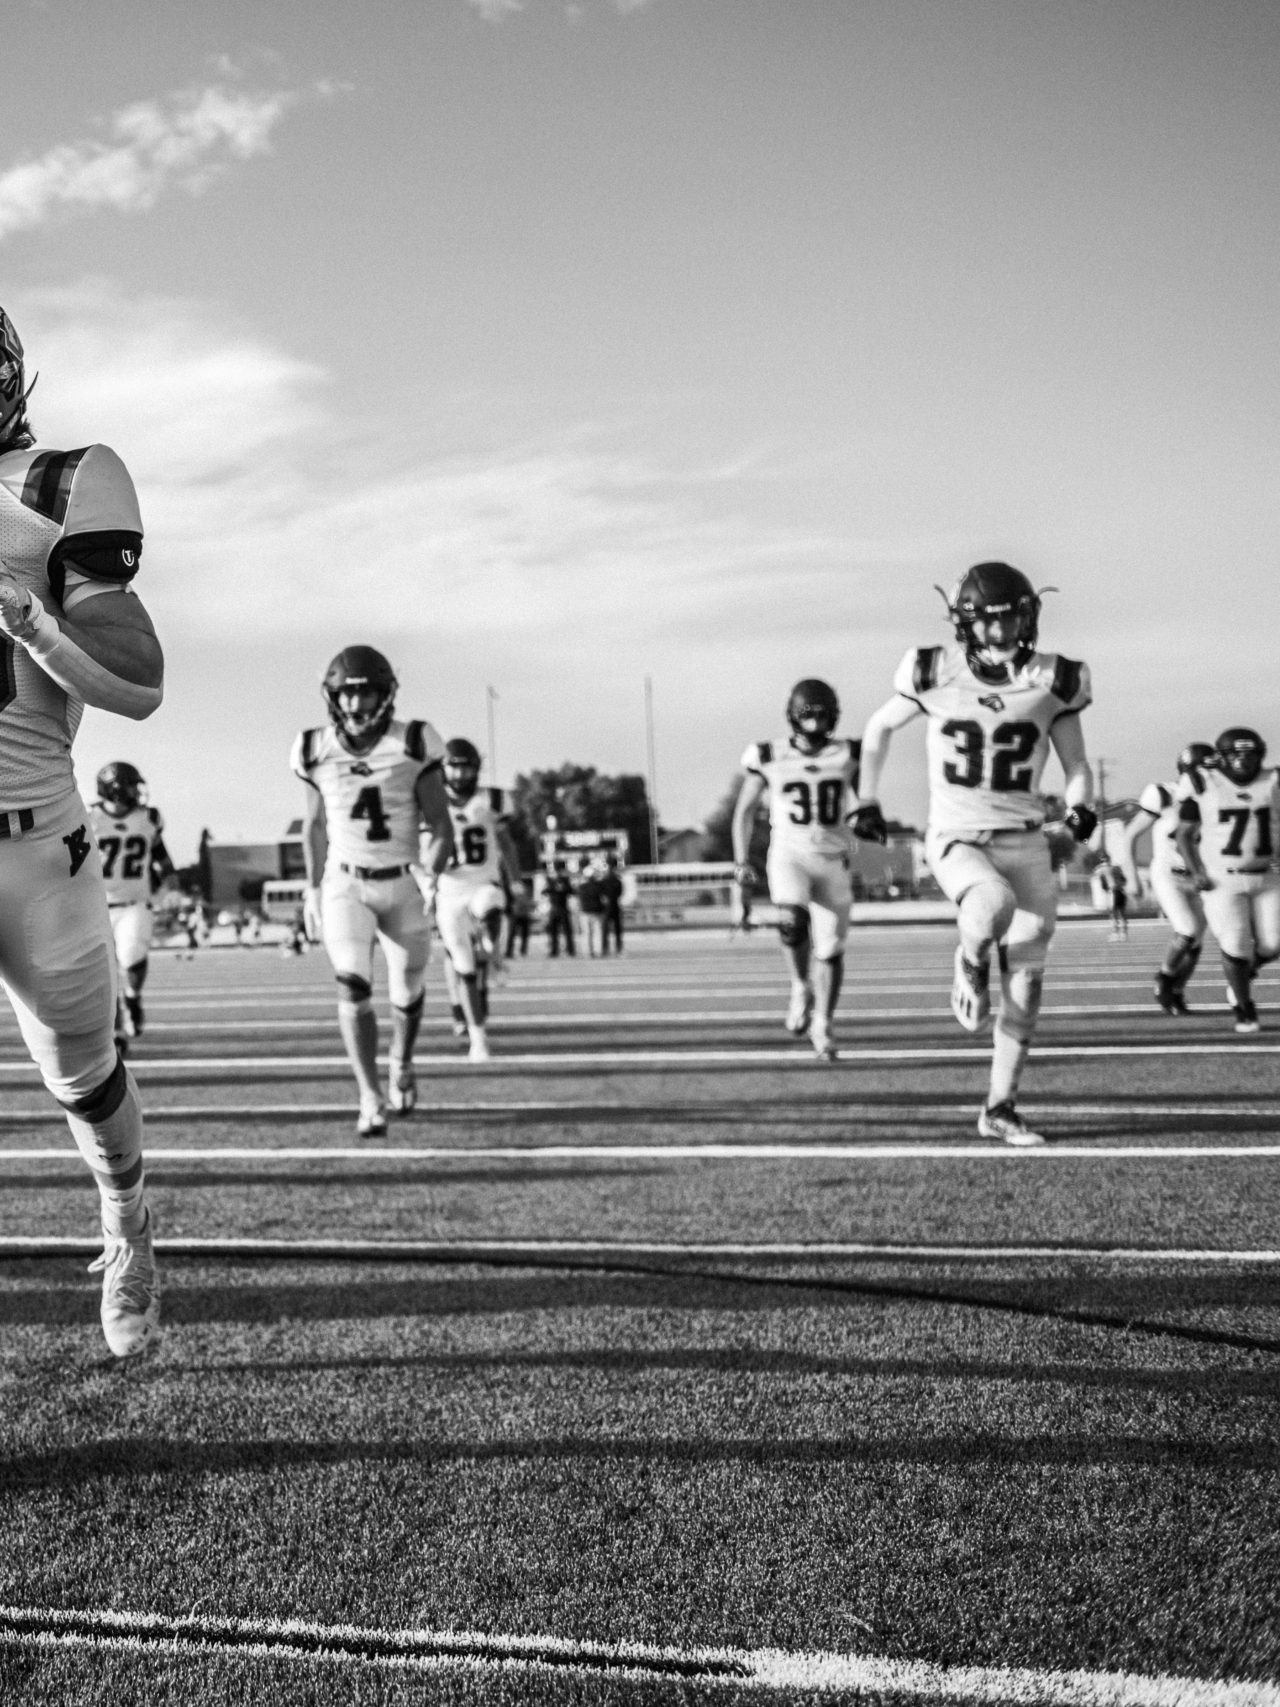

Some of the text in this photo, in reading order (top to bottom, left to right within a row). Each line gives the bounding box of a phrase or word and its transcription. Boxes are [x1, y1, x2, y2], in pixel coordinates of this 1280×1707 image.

[940, 718, 1041, 794] 32
[350, 785, 392, 842] 4
[782, 779, 844, 828] 30
[99, 834, 147, 880] 72
[1218, 805, 1273, 857] 71
